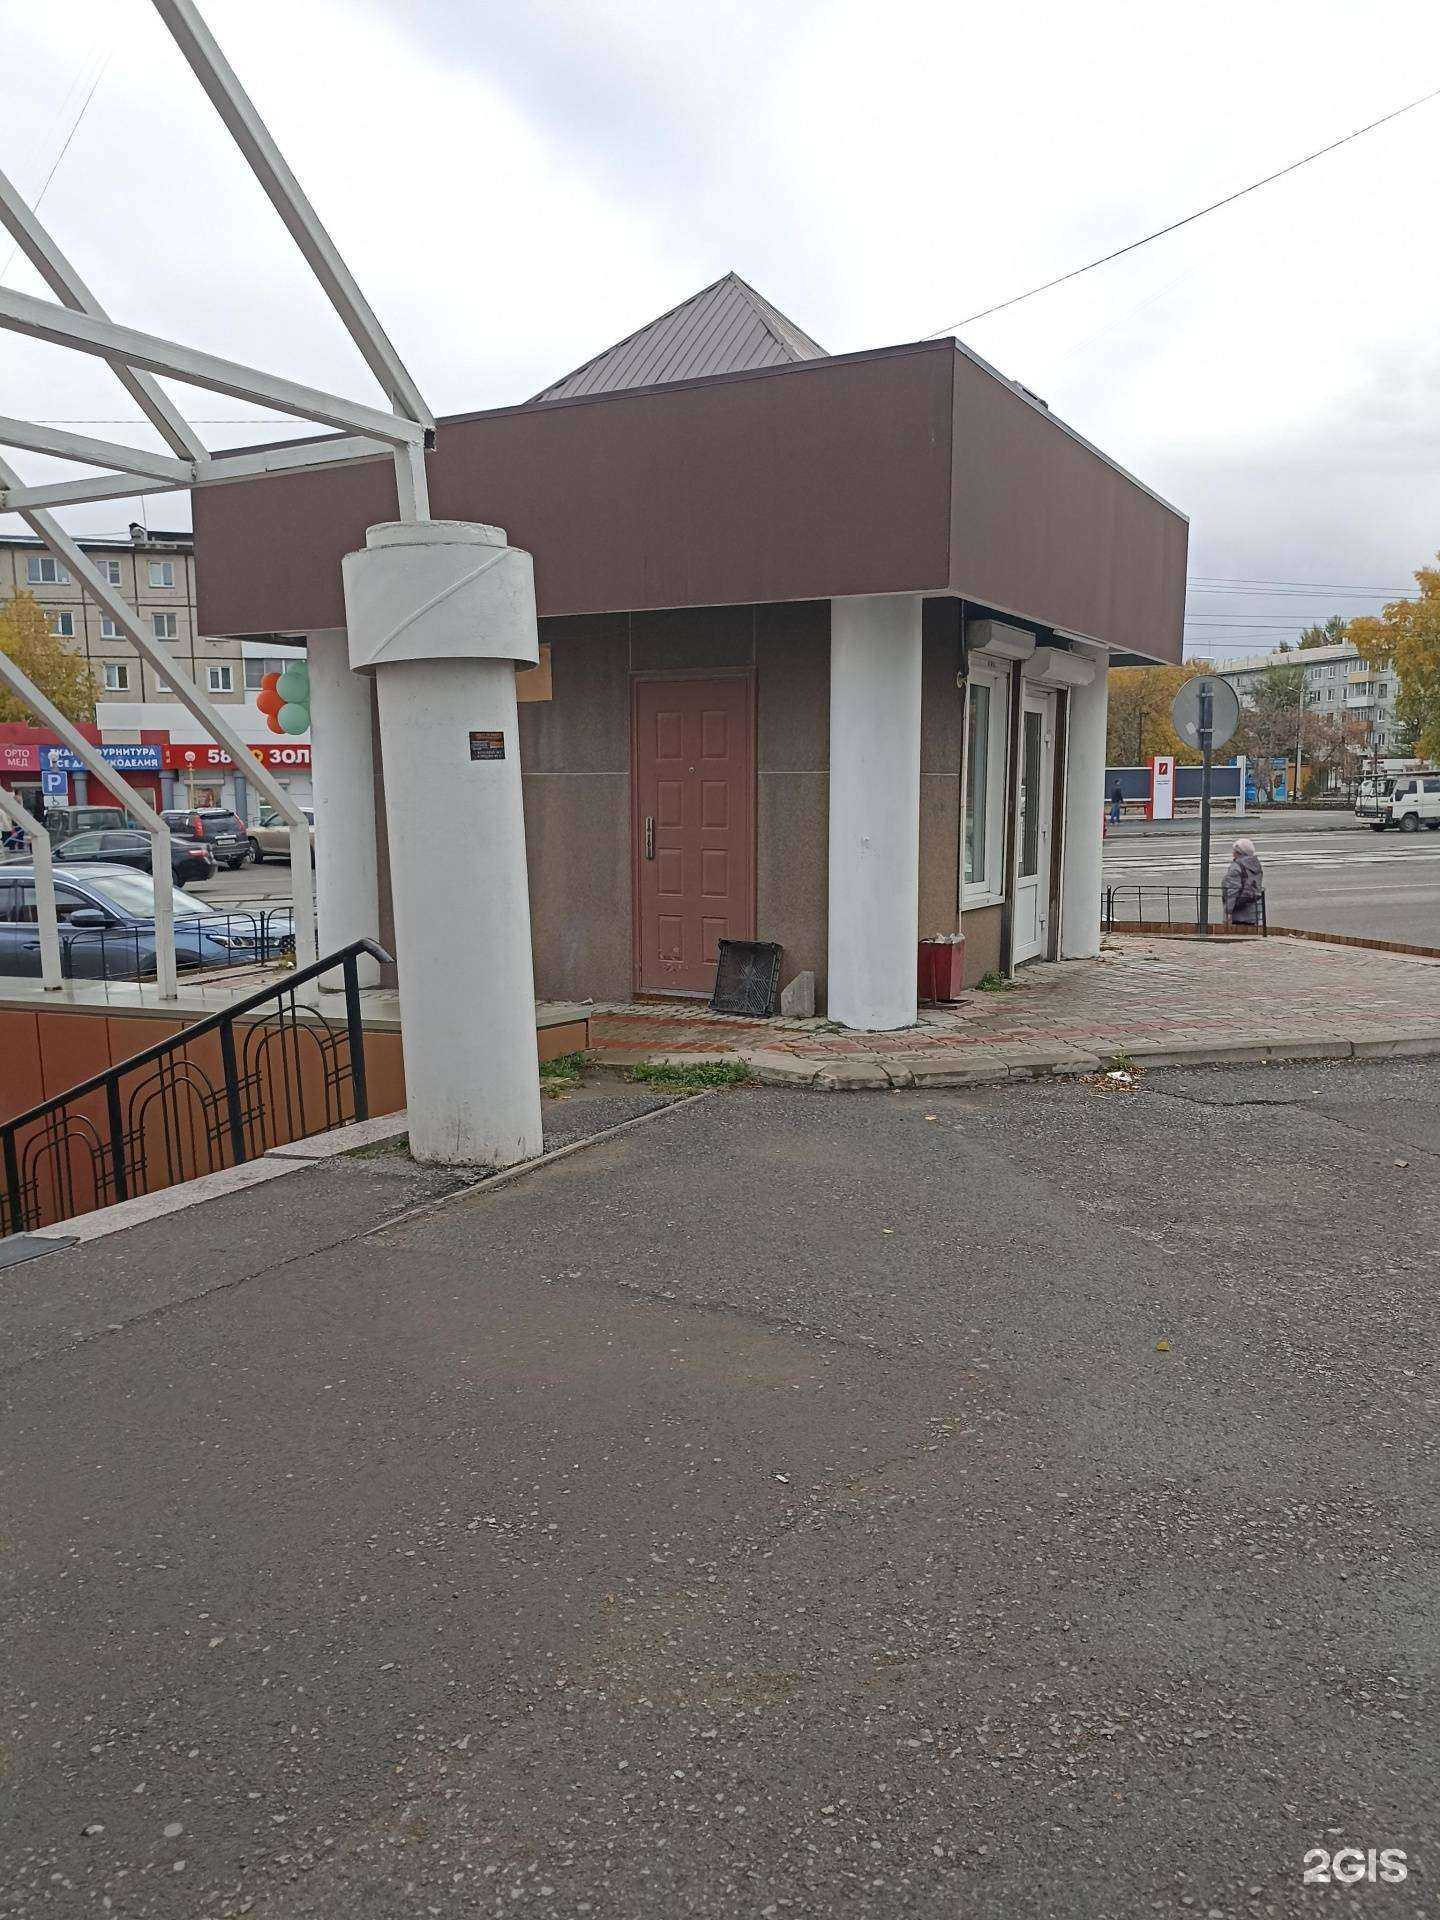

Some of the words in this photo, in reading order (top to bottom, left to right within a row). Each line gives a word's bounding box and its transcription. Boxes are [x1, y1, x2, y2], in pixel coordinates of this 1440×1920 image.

[4, 749, 30, 758] ОРТО
[208, 749, 232, 763] 58
[269, 749, 310, 763] ЗОЛ
[7, 759, 28, 767] МЕД
[47, 775, 61, 791] P
